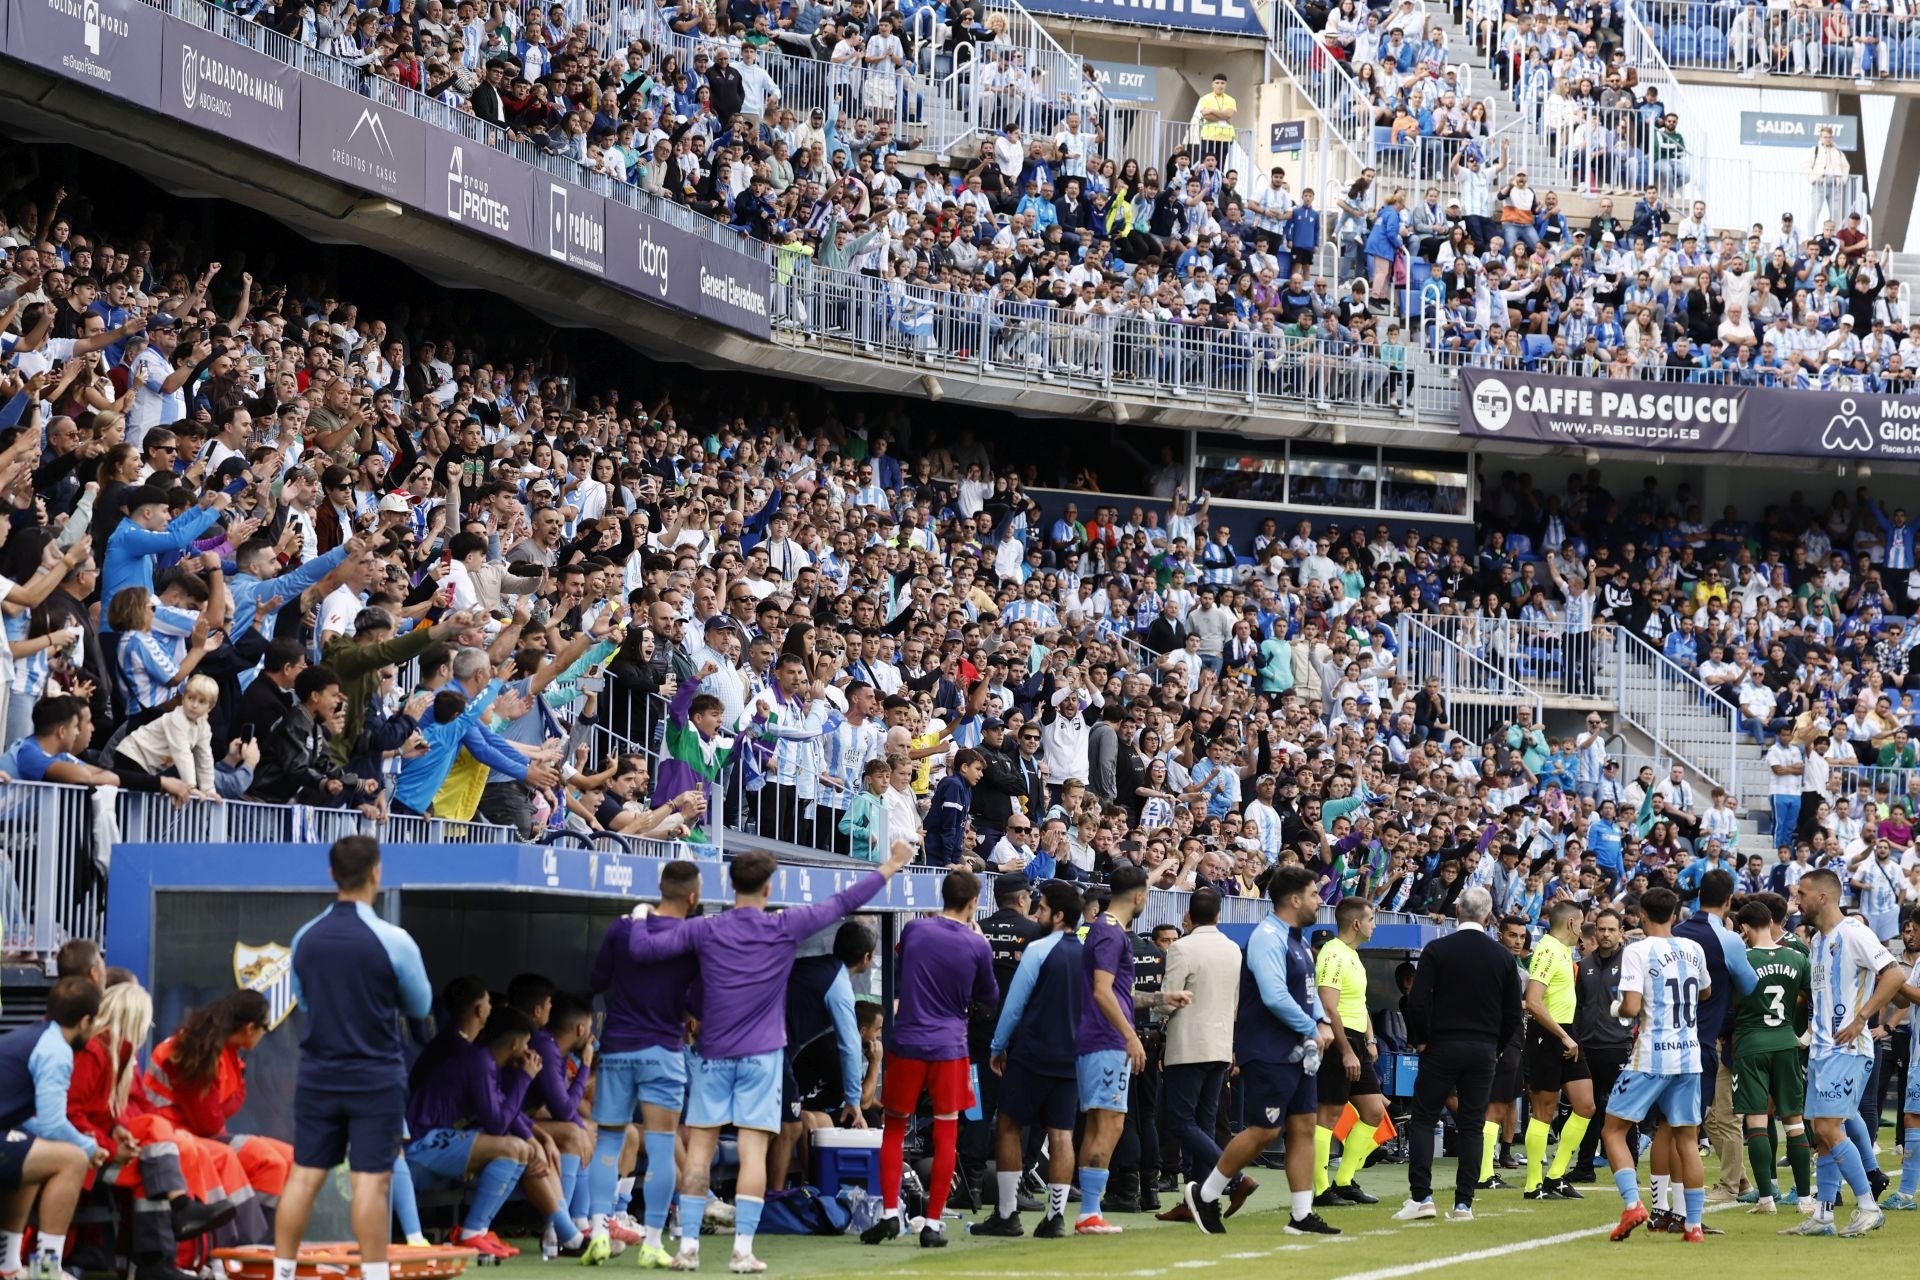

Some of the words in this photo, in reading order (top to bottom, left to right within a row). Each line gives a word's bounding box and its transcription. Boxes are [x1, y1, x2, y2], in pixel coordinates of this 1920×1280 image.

[100, 13, 129, 38] WORLD
[1119, 72, 1145, 87] EXIT
[199, 92, 232, 118] ABOGADOS
[1756, 120, 1805, 135] SALIDA
[1814, 123, 1844, 137] EIT
[332, 148, 366, 172] CRÉDITOS
[368, 161, 374, 175] Y
[376, 164, 397, 184] CASAS
[463, 174, 489, 196] group
[463, 189, 510, 231] PROTEC
[569, 211, 603, 254] redpiso
[700, 265, 728, 303] General
[1515, 385, 1593, 416] CAFFE
[1601, 392, 1738, 424] PASCUCCI
[1550, 421, 1700, 440] WWW.PASCUCCI.ES
[1881, 444, 1905, 454] Places
[984, 933, 1018, 942] OLICIA
[1132, 955, 1156, 964] OLICIA
[1648, 967, 1662, 978] D.
[1657, 950, 1702, 972] LARRUBI
[1756, 963, 1798, 980] RISTIAN
[1665, 976, 1699, 1029] 10
[1763, 984, 1786, 1027] 3
[1117, 1071, 1127, 1092] 5
[1819, 1090, 1842, 1099] MGS
